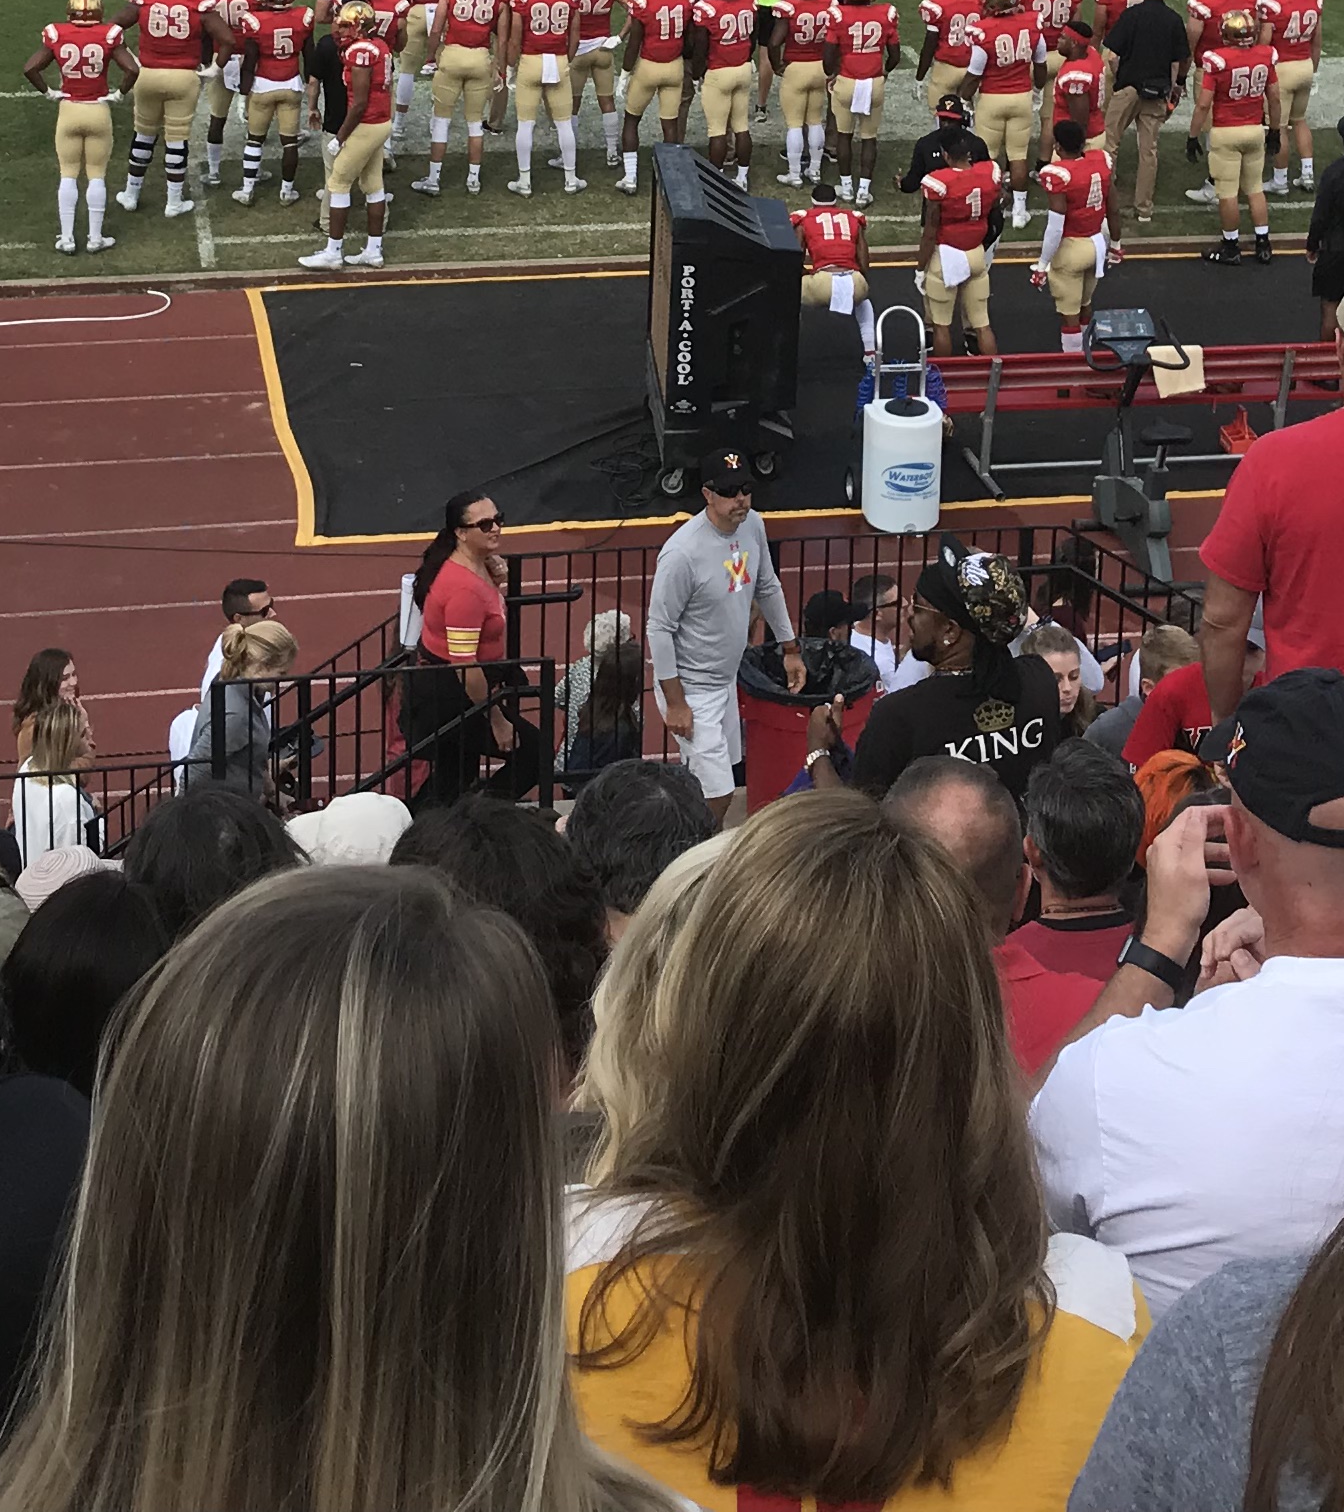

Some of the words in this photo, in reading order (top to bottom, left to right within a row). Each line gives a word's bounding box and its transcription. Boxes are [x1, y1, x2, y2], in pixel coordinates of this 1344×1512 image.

[147, 2, 191, 40] 63
[655, 4, 685, 40] 11
[718, 10, 754, 45] 20
[848, 20, 883, 54] 12
[1282, 10, 1319, 43] 42
[59, 42, 106, 80] 23
[272, 28, 295, 60] 5
[994, 28, 1033, 68] 94
[1228, 63, 1269, 101] 59
[965, 187, 983, 223] 1
[1086, 171, 1105, 212] 4
[814, 211, 852, 241] 11
[944, 716, 1045, 765] KING
